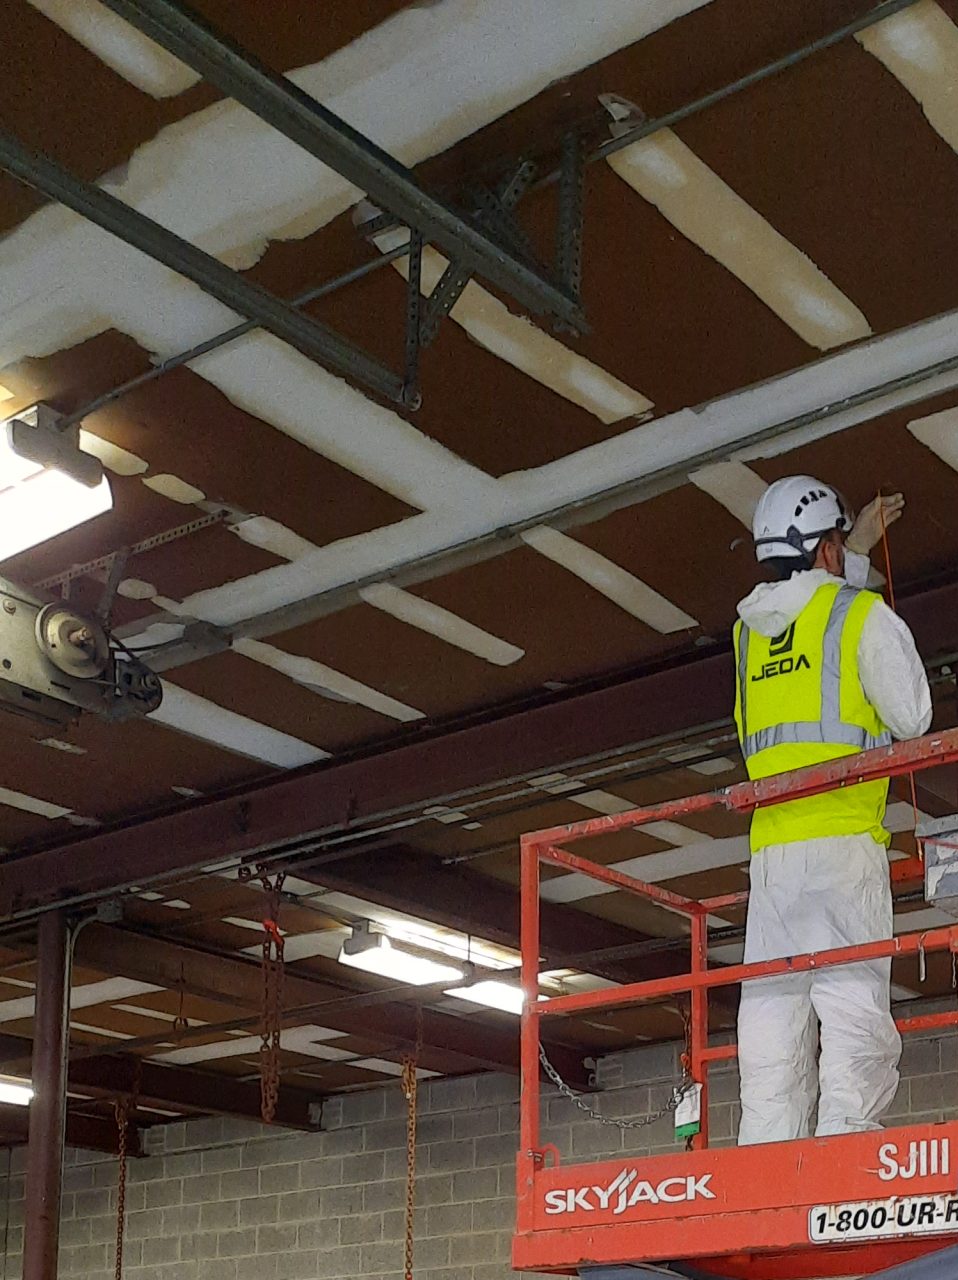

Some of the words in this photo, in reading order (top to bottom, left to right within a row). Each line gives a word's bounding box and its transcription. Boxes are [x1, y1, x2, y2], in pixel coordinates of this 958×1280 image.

[751, 654, 811, 682] JEDA
[878, 1137, 950, 1181] SJIII
[544, 1167, 717, 1215] SKYJACK
